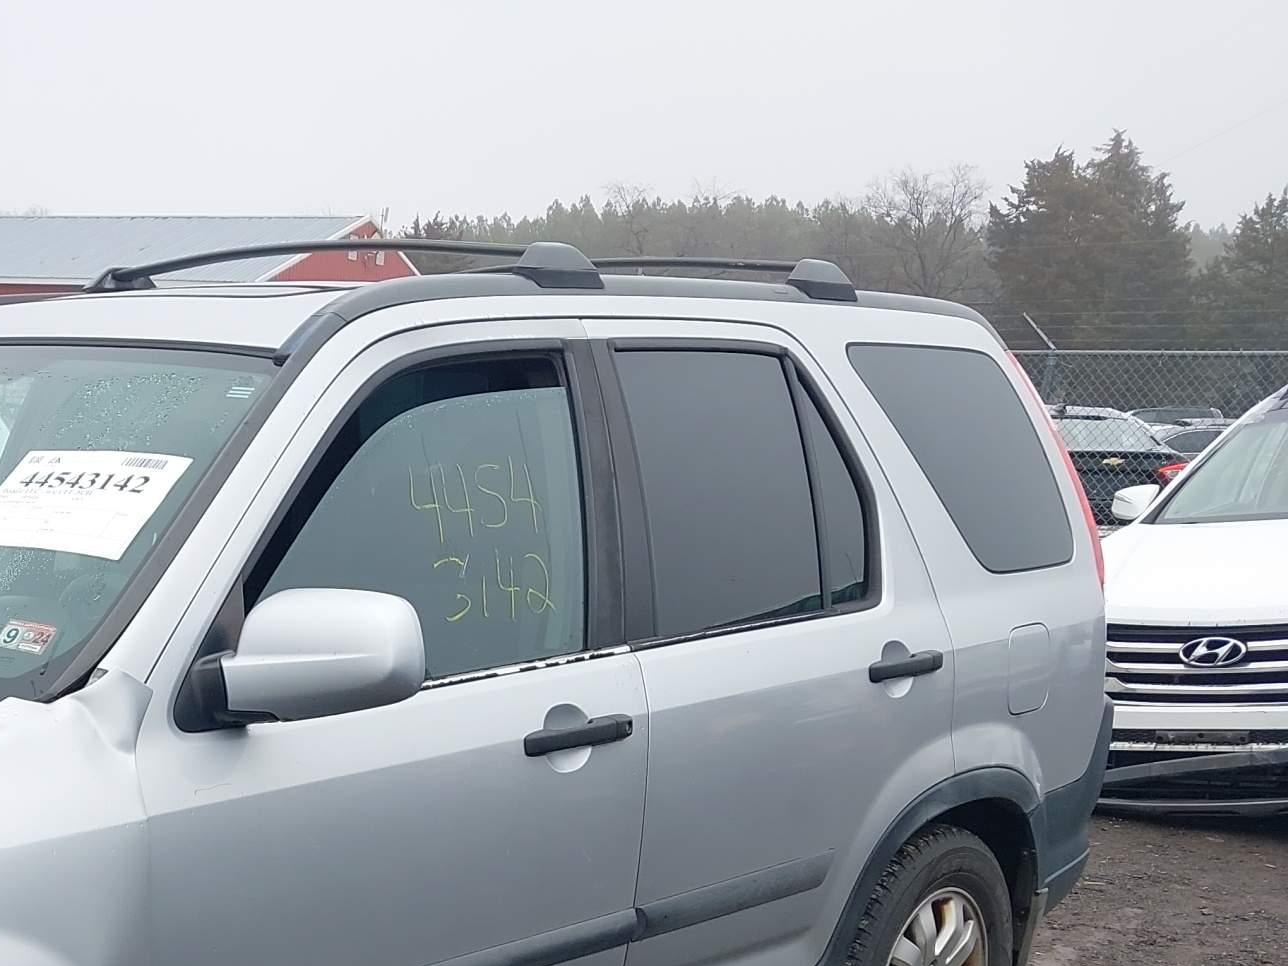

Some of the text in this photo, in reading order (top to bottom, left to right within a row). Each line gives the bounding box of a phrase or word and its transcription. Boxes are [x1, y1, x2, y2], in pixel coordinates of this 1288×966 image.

[20, 471, 151, 494] 44543142
[408, 456, 543, 543] 4454
[433, 548, 557, 622] 3142
[3, 628, 20, 644] 9
